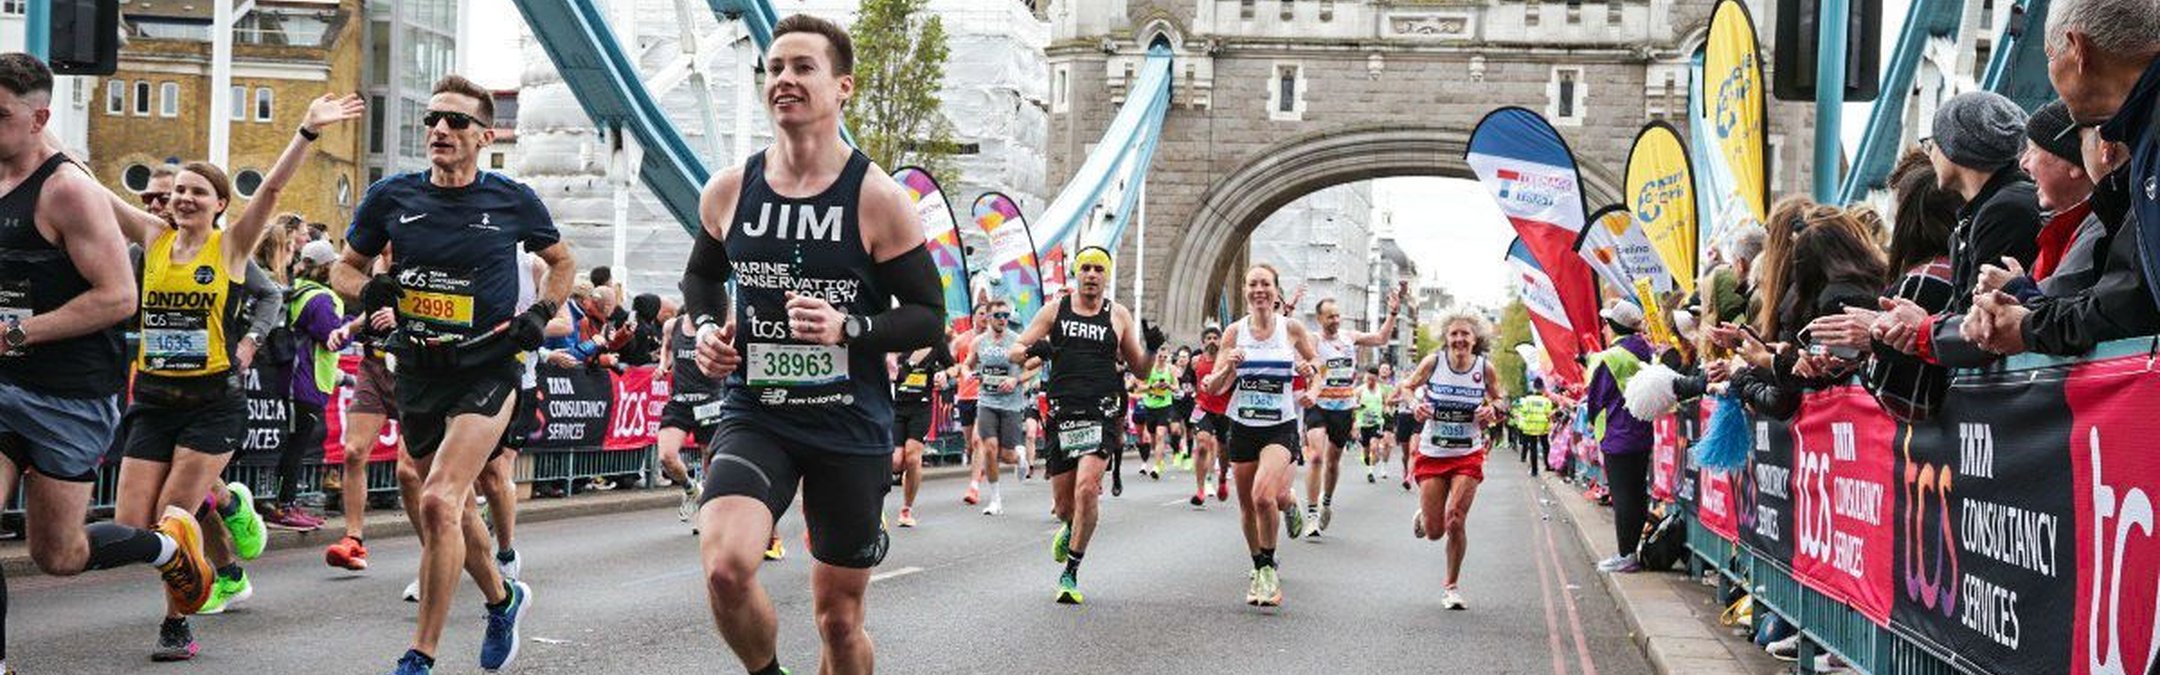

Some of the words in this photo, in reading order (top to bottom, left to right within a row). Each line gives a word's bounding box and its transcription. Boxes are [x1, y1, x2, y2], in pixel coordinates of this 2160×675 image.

[743, 202, 843, 242] JIM
[730, 261, 790, 276] MARINE
[145, 290, 218, 309] ONDON
[411, 297, 455, 318] 2998
[797, 288, 858, 304] OCIETY
[751, 315, 787, 339] tcs
[1060, 319, 1108, 341] YERRY
[156, 334, 193, 351] 1635
[763, 351, 834, 377] 38963
[546, 377, 575, 394] TATA
[549, 400, 608, 418] CONSULTANCY
[612, 380, 648, 438] tcs
[547, 421, 586, 440] SERVICES
[1959, 422, 1994, 480] TATA
[1795, 424, 1833, 564] tcs
[1833, 476, 1884, 526] CONSULTANCY
[1903, 424, 1958, 618] tcs
[1960, 497, 2057, 578] CONSULTANCY
[2089, 425, 2160, 675] tc
[1961, 573, 2020, 651] SERVICES
